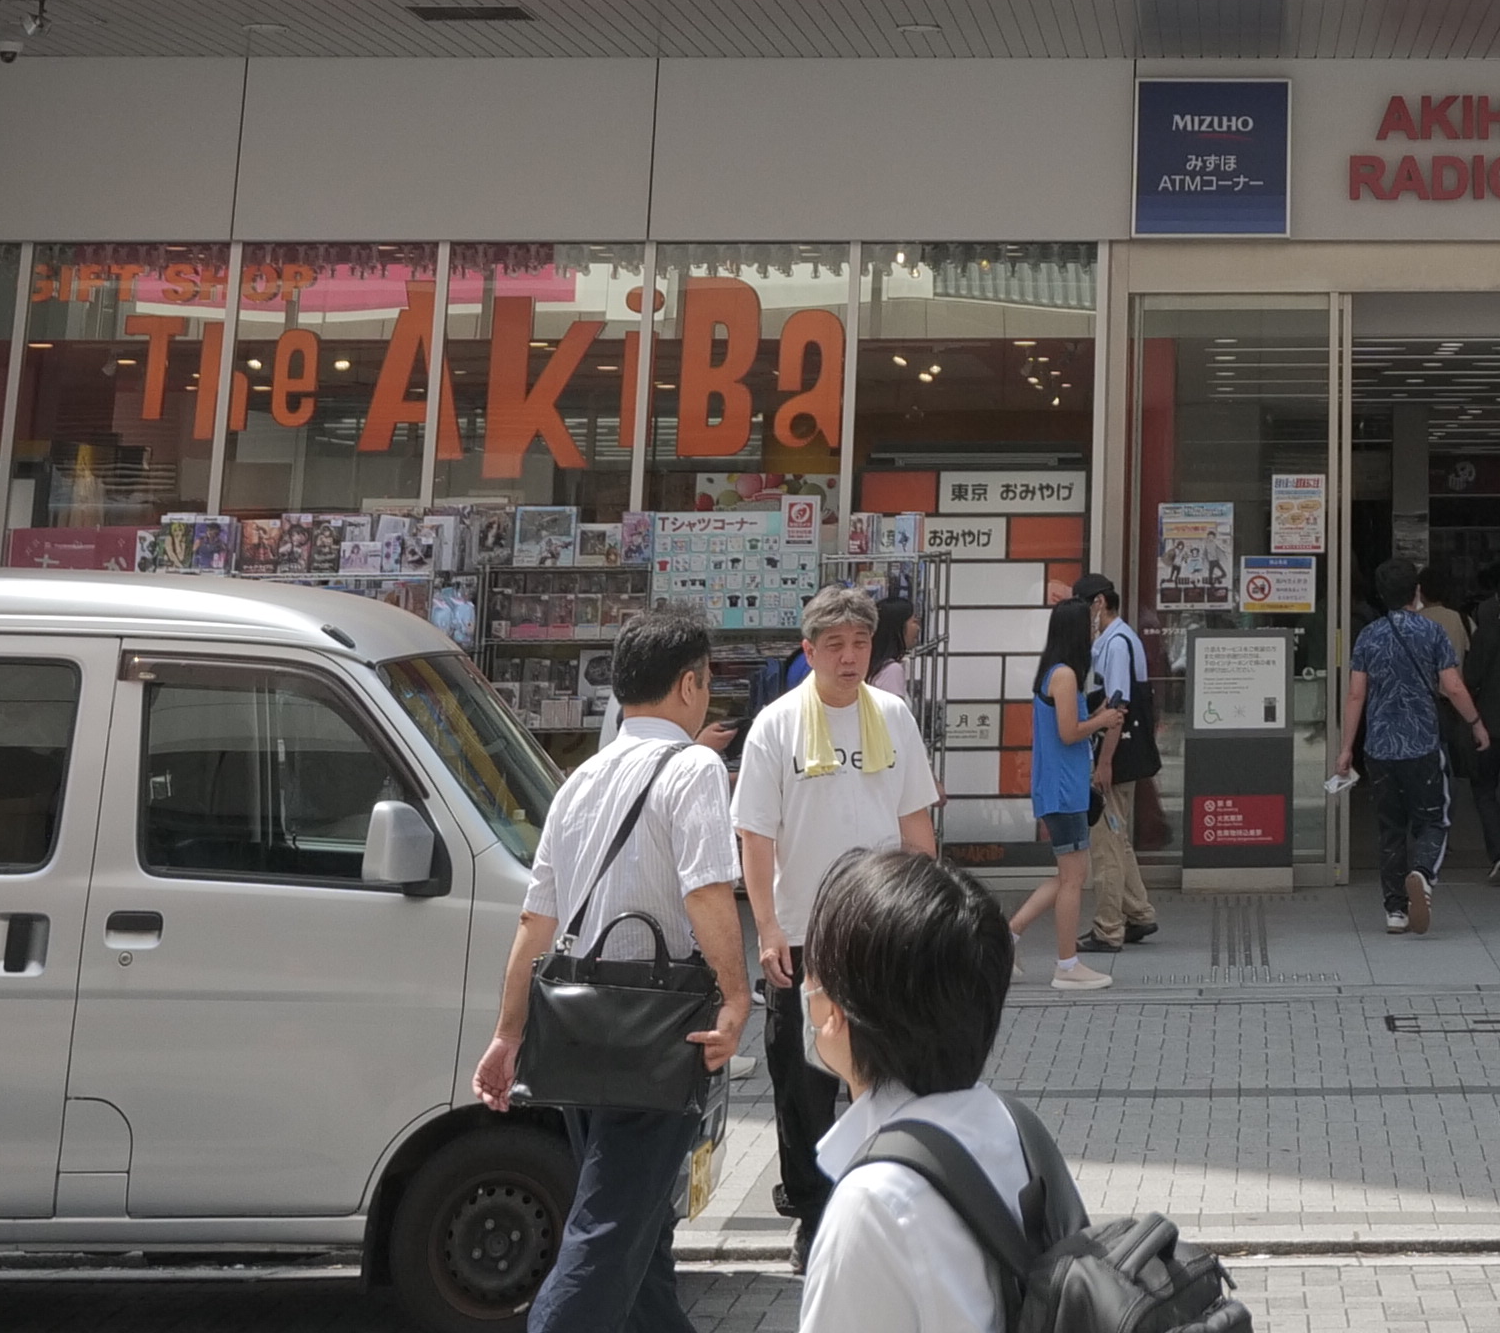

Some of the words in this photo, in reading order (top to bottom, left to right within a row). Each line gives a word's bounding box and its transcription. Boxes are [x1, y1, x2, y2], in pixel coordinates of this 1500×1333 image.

[1171, 113, 1255, 133] MIZUHO
[1185, 153, 1238, 174] みずほ
[1157, 173, 1264, 194] ATMコーナー
[30, 262, 146, 304] GIFT
[124, 315, 320, 442] The
[950, 482, 989, 502] 東京
[999, 482, 1075, 502] おみやげ
[657, 515, 760, 533] Tシャツコーナー
[928, 529, 993, 549] おみやげ
